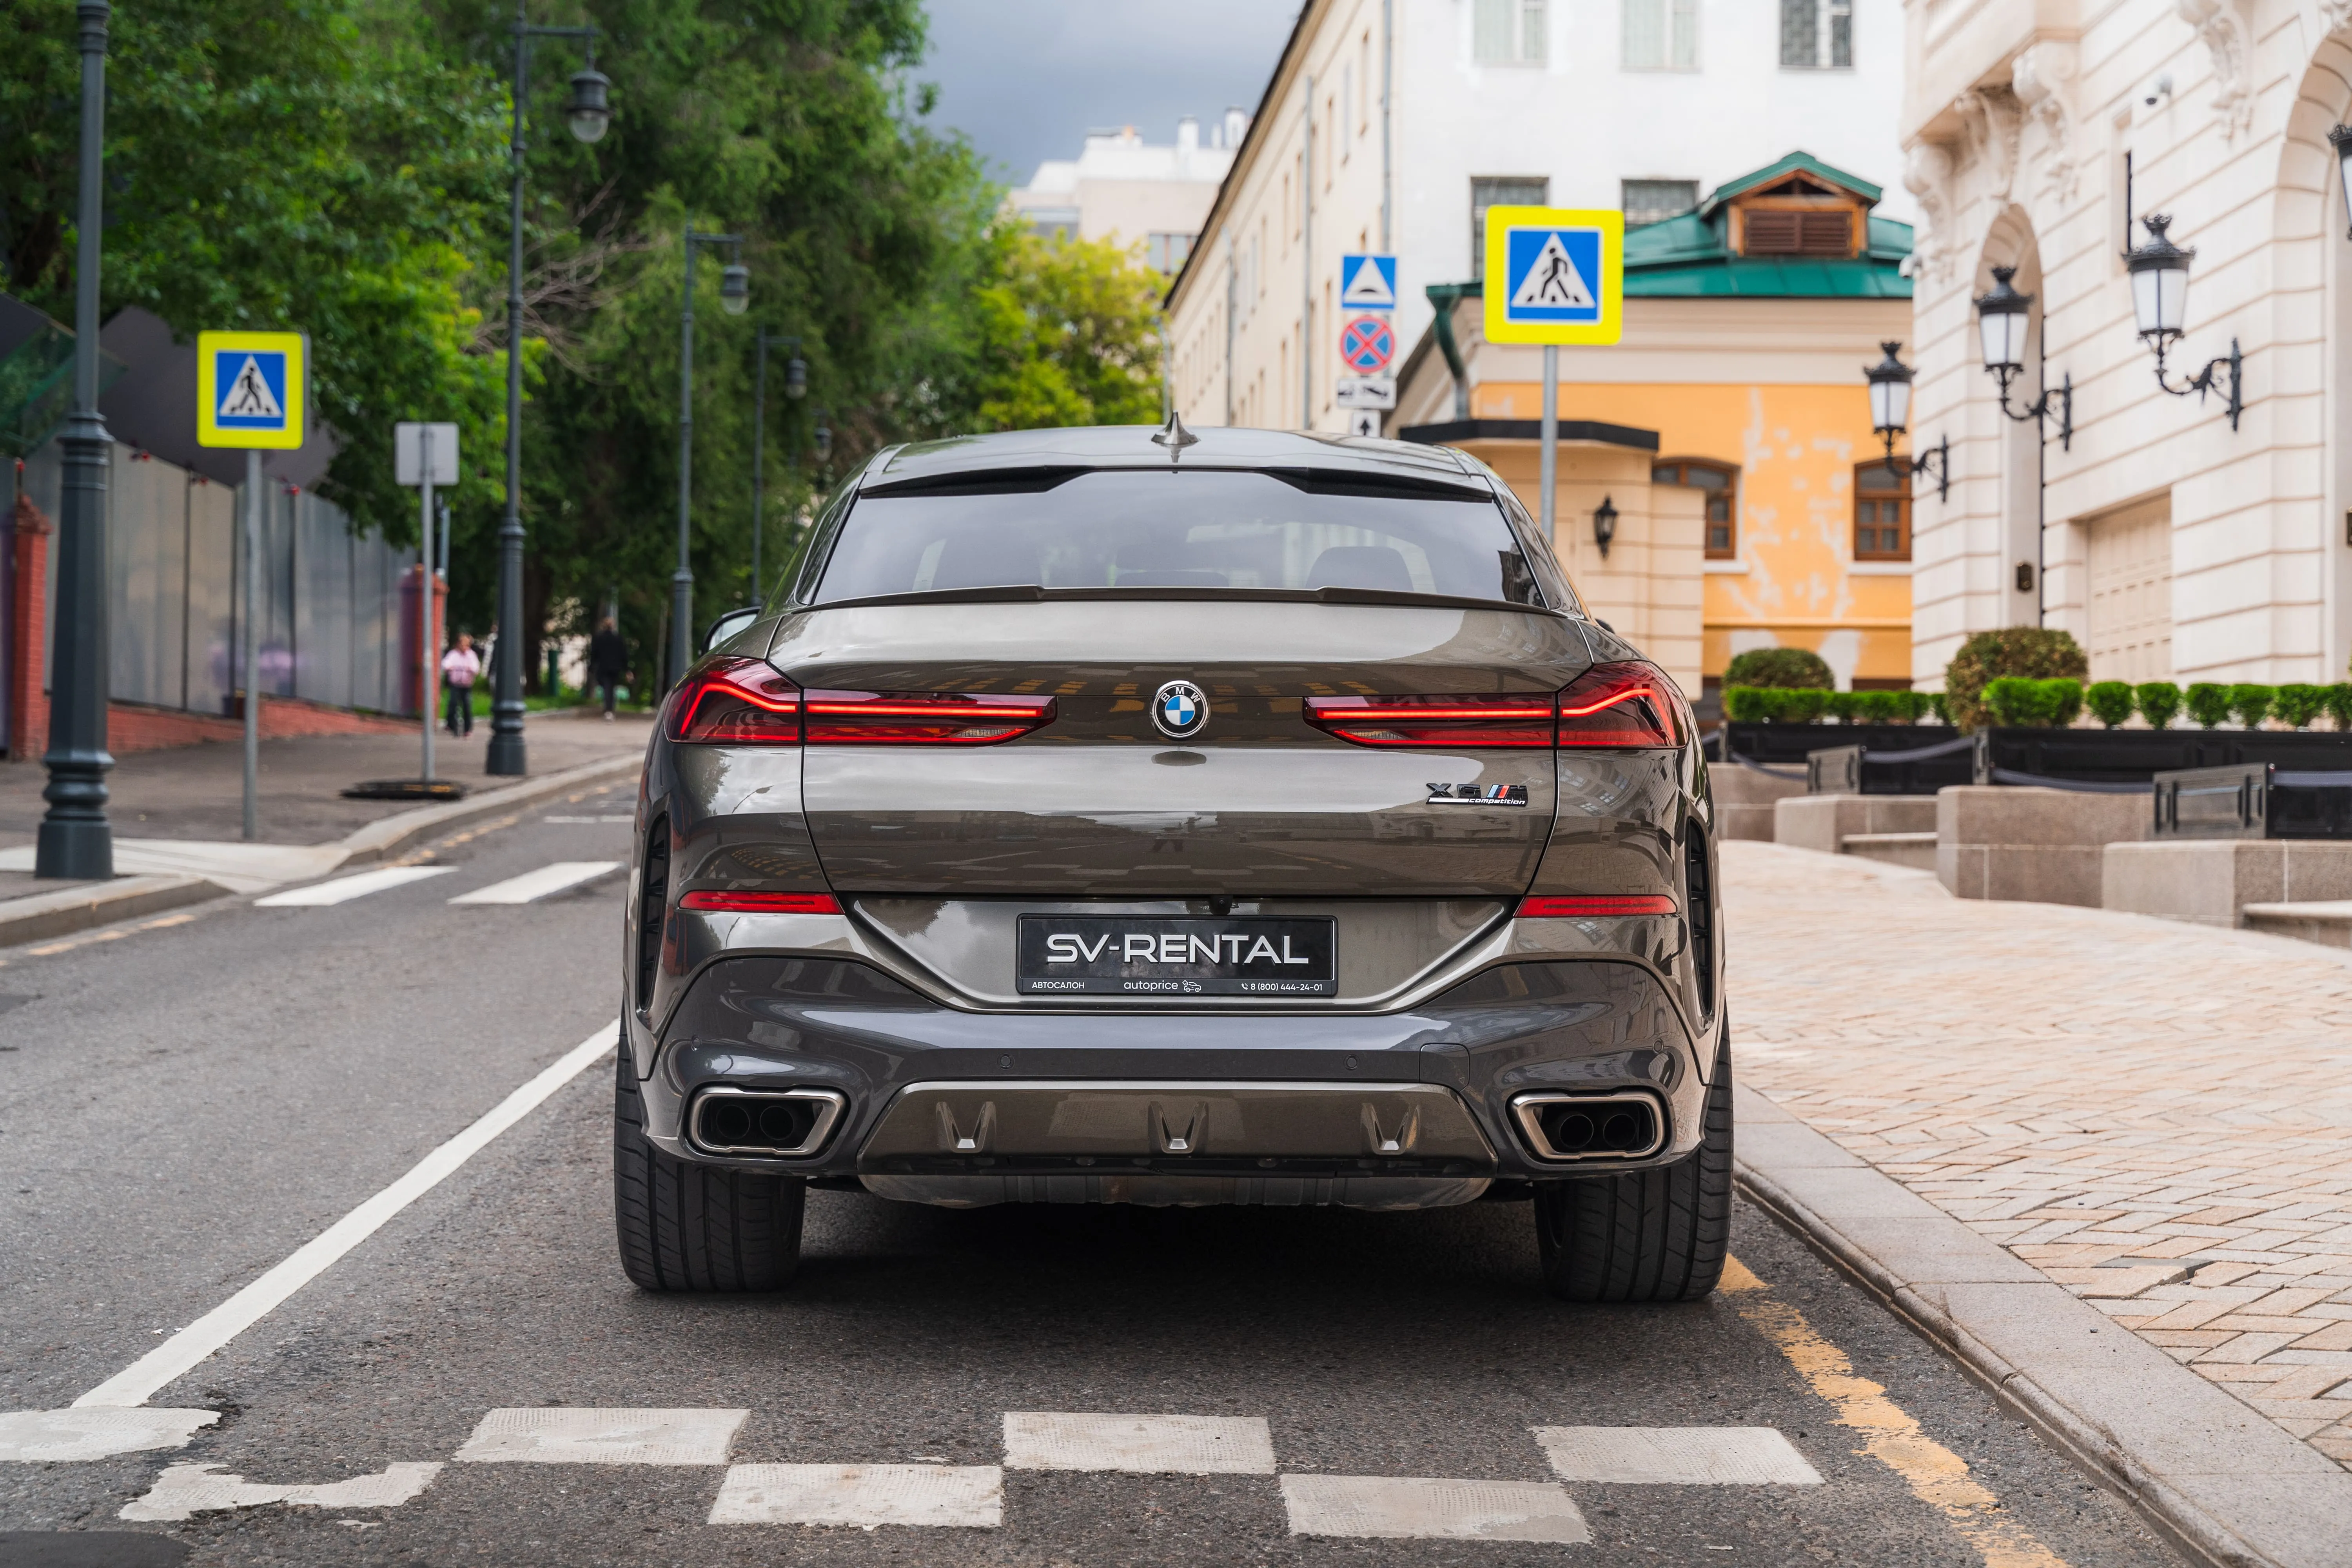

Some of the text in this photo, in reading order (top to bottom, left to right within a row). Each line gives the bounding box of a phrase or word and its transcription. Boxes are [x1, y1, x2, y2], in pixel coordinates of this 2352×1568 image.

[1160, 687, 1200, 702] BMW
[1047, 934, 1309, 964] SV-RENTAL
[1032, 981, 1085, 989] АВТОСАЛОН
[1123, 980, 1178, 992] autoprice
[1257, 982, 1278, 991] (800)
[1280, 983, 1323, 991] 444-24-01
